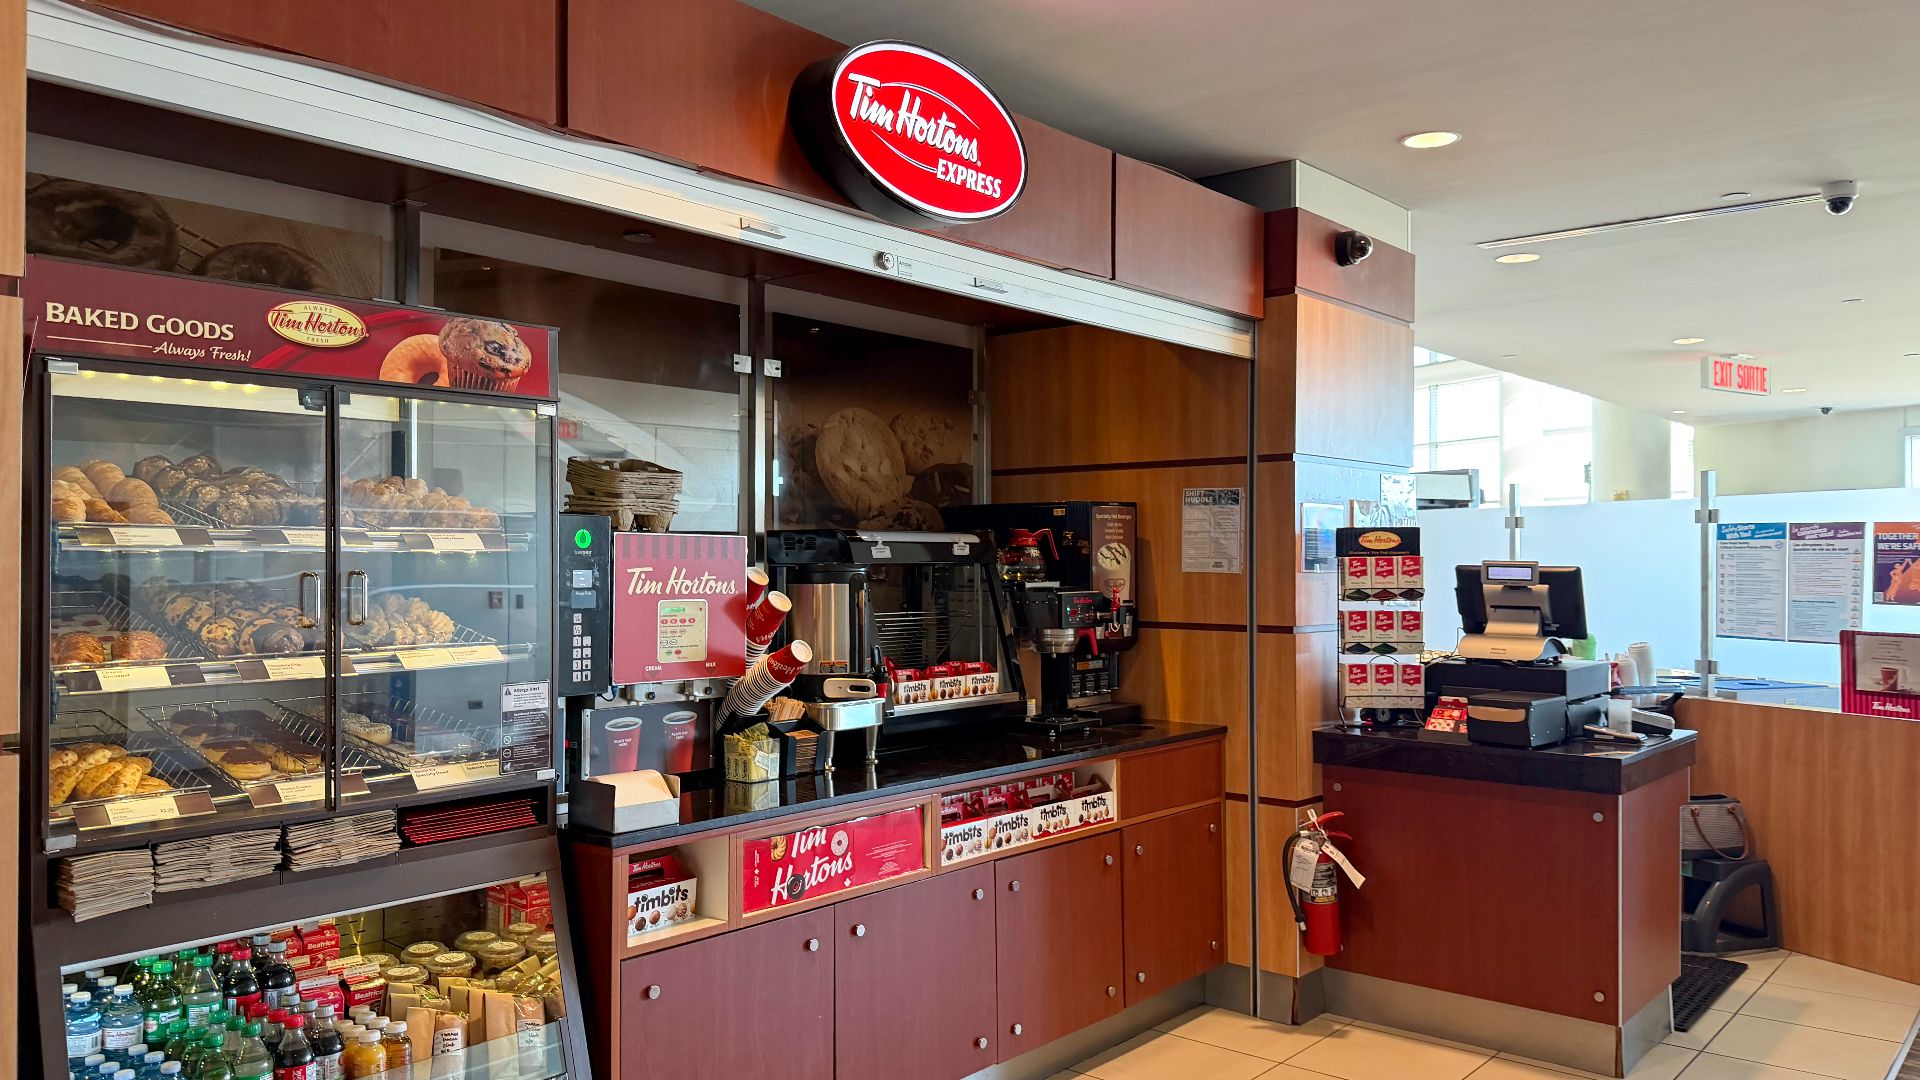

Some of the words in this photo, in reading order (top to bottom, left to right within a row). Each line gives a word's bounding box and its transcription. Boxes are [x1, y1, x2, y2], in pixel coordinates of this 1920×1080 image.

[848, 72, 894, 132] Tim
[896, 89, 979, 164] Hortons
[937, 158, 1002, 199] EXPRESS
[303, 304, 333, 314] ALWAYS
[45, 301, 139, 331] BAKED
[146, 313, 235, 342] GOODS
[271, 308, 303, 331] Tim
[304, 311, 368, 338] Hortons
[306, 336, 330, 344] FRESH
[152, 342, 205, 360] Always
[209, 345, 251, 363] Fresh!
[1713, 360, 1733, 388] EXIT
[1737, 364, 1768, 393] SORTIE
[1877, 533, 1918, 541] TOGETHER
[627, 566, 662, 595] Tim
[665, 566, 736, 595] Hortons
[903, 682, 927, 693] timbits
[940, 678, 962, 688] timbits
[971, 675, 995, 685] timbits
[1871, 701, 1885, 711] Tim
[1040, 803, 1067, 821] timbits
[1081, 795, 1107, 812] timbits
[994, 816, 1029, 834] timbits
[944, 825, 983, 846] timbits
[635, 885, 689, 913] timbits
[307, 940, 336, 950] Beatrice
